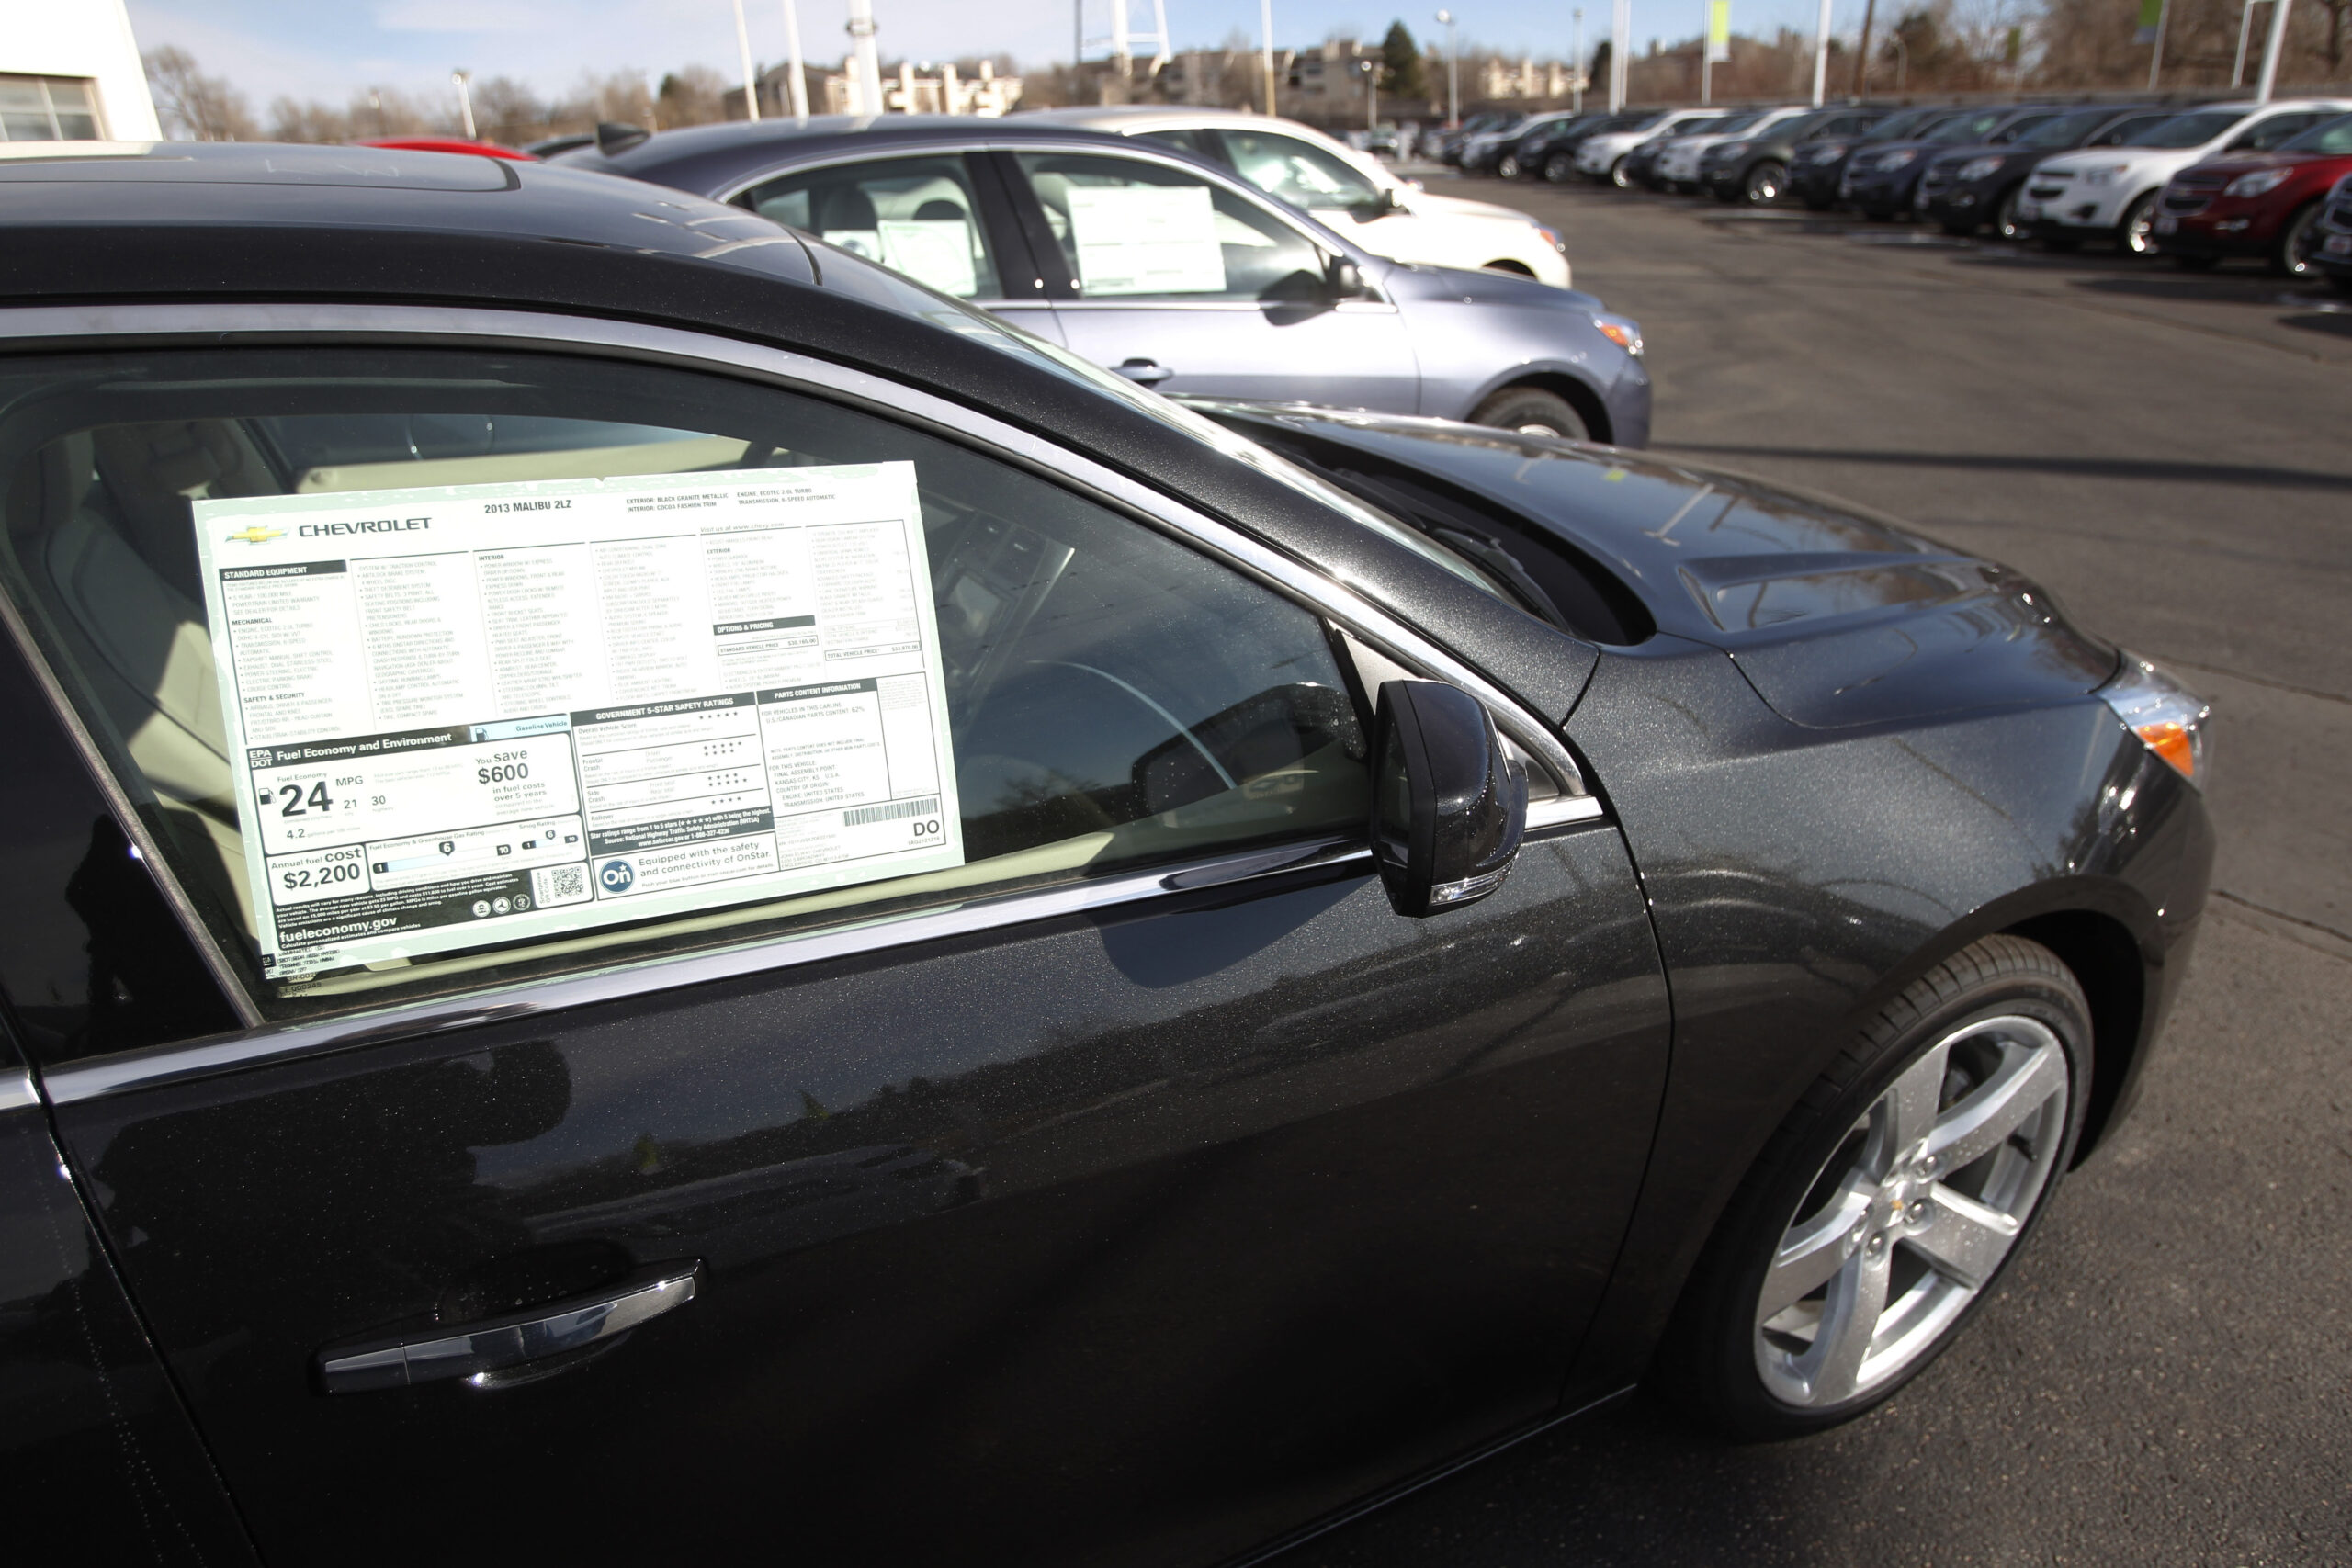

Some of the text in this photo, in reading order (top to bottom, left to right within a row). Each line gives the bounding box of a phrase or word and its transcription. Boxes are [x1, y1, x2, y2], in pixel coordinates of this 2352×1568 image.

[701, 492, 729, 501] METALLIC
[483, 499, 572, 514] 2013 MALIBU 2LZ
[676, 502, 702, 510] FASHION
[298, 516, 433, 538] CHEVROLET
[478, 553, 505, 562] INTERIOR
[706, 547, 731, 555] EXTERIOR
[223, 566, 308, 581] STANDARD EQUIPMENT
[231, 617, 273, 626] MECHANICAL
[716, 621, 774, 634] OPTIONS & PRICING
[745, 643, 764, 651] VEHICLE
[774, 682, 862, 700] PARTS CONTENT INFORMATION
[243, 695, 268, 704] SAFETY
[275, 692, 306, 701] SECURITY
[595, 697, 735, 721] GOVERNMENT 5-STAR SAFETY RATINGS
[514, 720, 569, 733] Gasoline Vehicle
[577, 727, 599, 736] Overall
[598, 724, 620, 733] Vehicle
[620, 722, 638, 730] Score
[276, 732, 453, 761] Fuel Economy and Environment
[248, 748, 273, 759] EPA
[492, 750, 529, 763] save
[250, 757, 274, 769] DOT
[475, 757, 492, 766] You
[277, 772, 328, 784] Fuel Economy
[477, 762, 530, 786] $600
[335, 775, 365, 788] MPG
[492, 782, 547, 795] in fuel costs
[278, 780, 334, 818] 24
[371, 795, 387, 807] 30
[493, 790, 548, 803] over 5 years
[343, 798, 358, 810] 21
[286, 828, 306, 840] 4.2
[547, 830, 554, 839] 6
[912, 818, 941, 838] DO
[442, 842, 452, 853] 6
[498, 845, 510, 855] 10
[638, 841, 760, 867] Equipped with the safety
[324, 847, 363, 863] cost
[270, 856, 323, 871] Annual fuel
[639, 866, 660, 878] and
[661, 858, 722, 874] connectivity
[723, 854, 734, 865] of
[283, 863, 361, 891] $2,200
[601, 864, 632, 887] On
[279, 917, 397, 942] fueleconomy.gov
[280, 923, 422, 950] Calculate personalized estimates and compare vehicles
